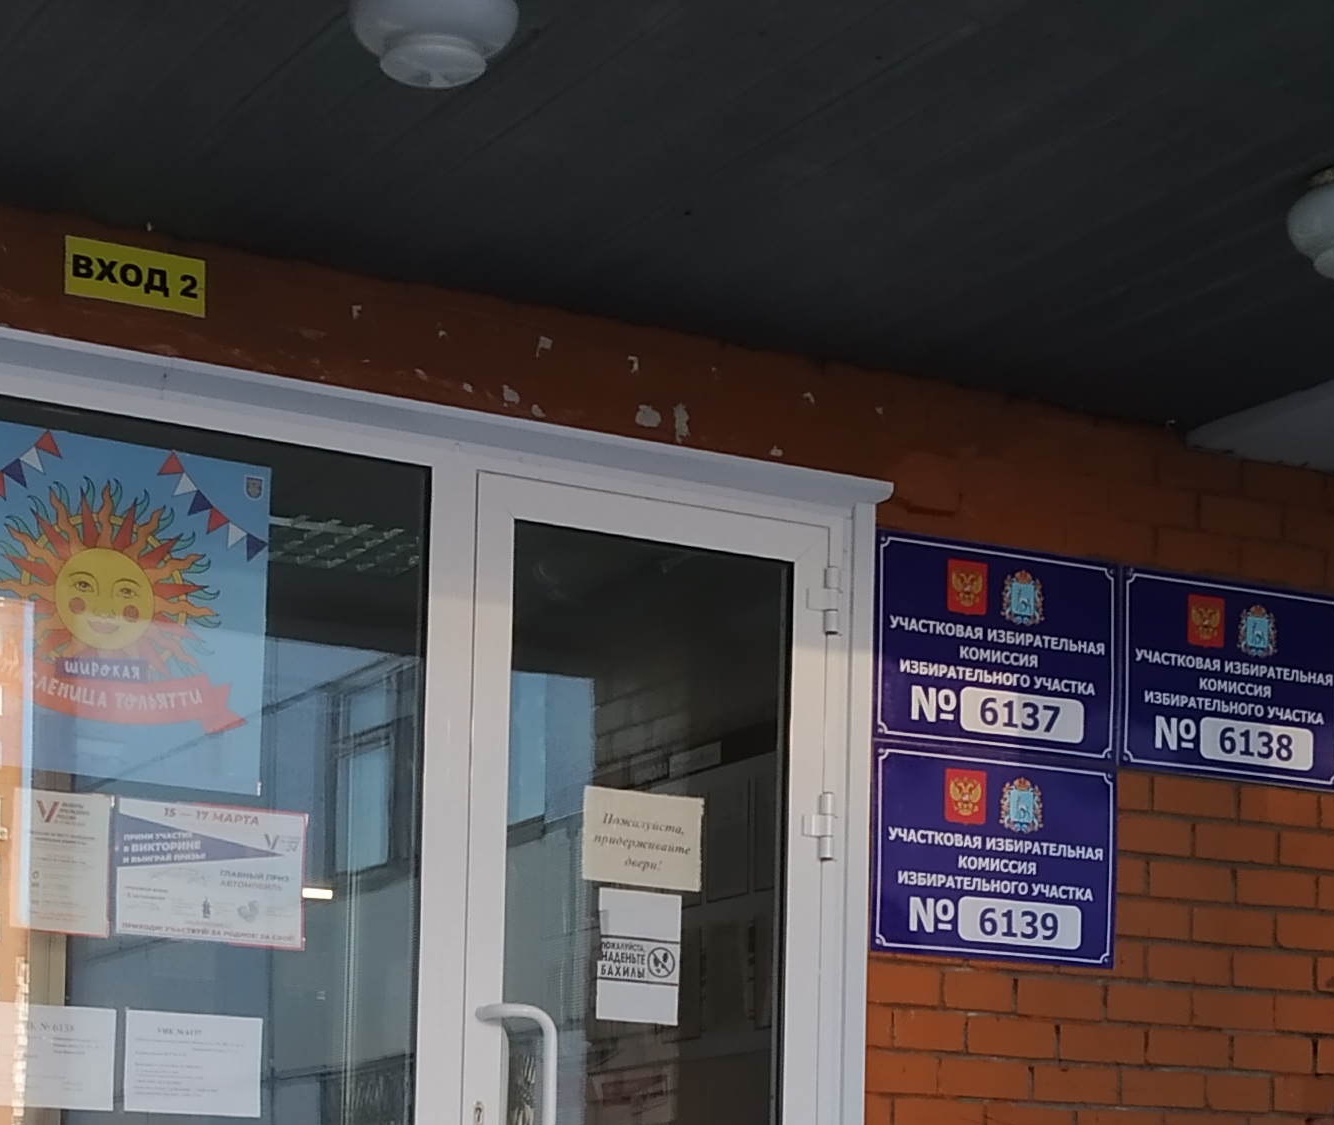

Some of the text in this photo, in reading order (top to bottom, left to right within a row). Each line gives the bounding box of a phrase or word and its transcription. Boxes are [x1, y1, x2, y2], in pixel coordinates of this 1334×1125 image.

[72, 253, 198, 299] ВХОД 2
[889, 615, 1105, 656] УЧАСТКОВАЯ ИЗБИРАТЕЛЬНАЯ
[959, 646, 1038, 668] КОМИССИЯ
[1135, 648, 1334, 687] УЧАСТКОВАЯ ИЗБИРАТЕЛЬНАЯ
[64, 660, 141, 681] ШИРОКАЯ
[899, 658, 1096, 696] ИЗБИРАТЕЛЬНОГО УЧАСТКА
[1199, 677, 1272, 698] КОМИССИЯ
[115, 689, 203, 710] ТОЛЬЯТТИ
[910, 685, 1061, 734] № 6137
[1144, 690, 1325, 725] ИЗБИРАТЕЛЬНОГО УЧАСТКА
[1154, 715, 1294, 762] № 6138
[163, 807, 176, 818] 15
[196, 810, 208, 821] 17
[212, 812, 260, 826] МАРТА
[602, 812, 685, 836] Пожалуйста,
[131, 841, 202, 852] ВИКТОРИНЕ
[593, 834, 691, 855] придерживайте
[888, 826, 1104, 861] УЧАСТКОВАЯ ИЗБИРАТЕЛЬНАЯ
[131, 853, 172, 863] ВЫИГРАЙ
[624, 856, 663, 872] двери!
[958, 854, 1037, 876] КОМИССИЯ
[220, 869, 290, 883] ГЛАВНЫЙ ПРИЗ
[220, 881, 283, 892] АВТОМОБИЛЬ
[897, 870, 1094, 902] ИЗБИРАТЕЛЬНОГО УЧАСТКА
[908, 896, 1059, 941] № 6139
[602, 951, 646, 965] НАДЕНЬТЕ
[601, 964, 646, 978] БАХИЛЫ
